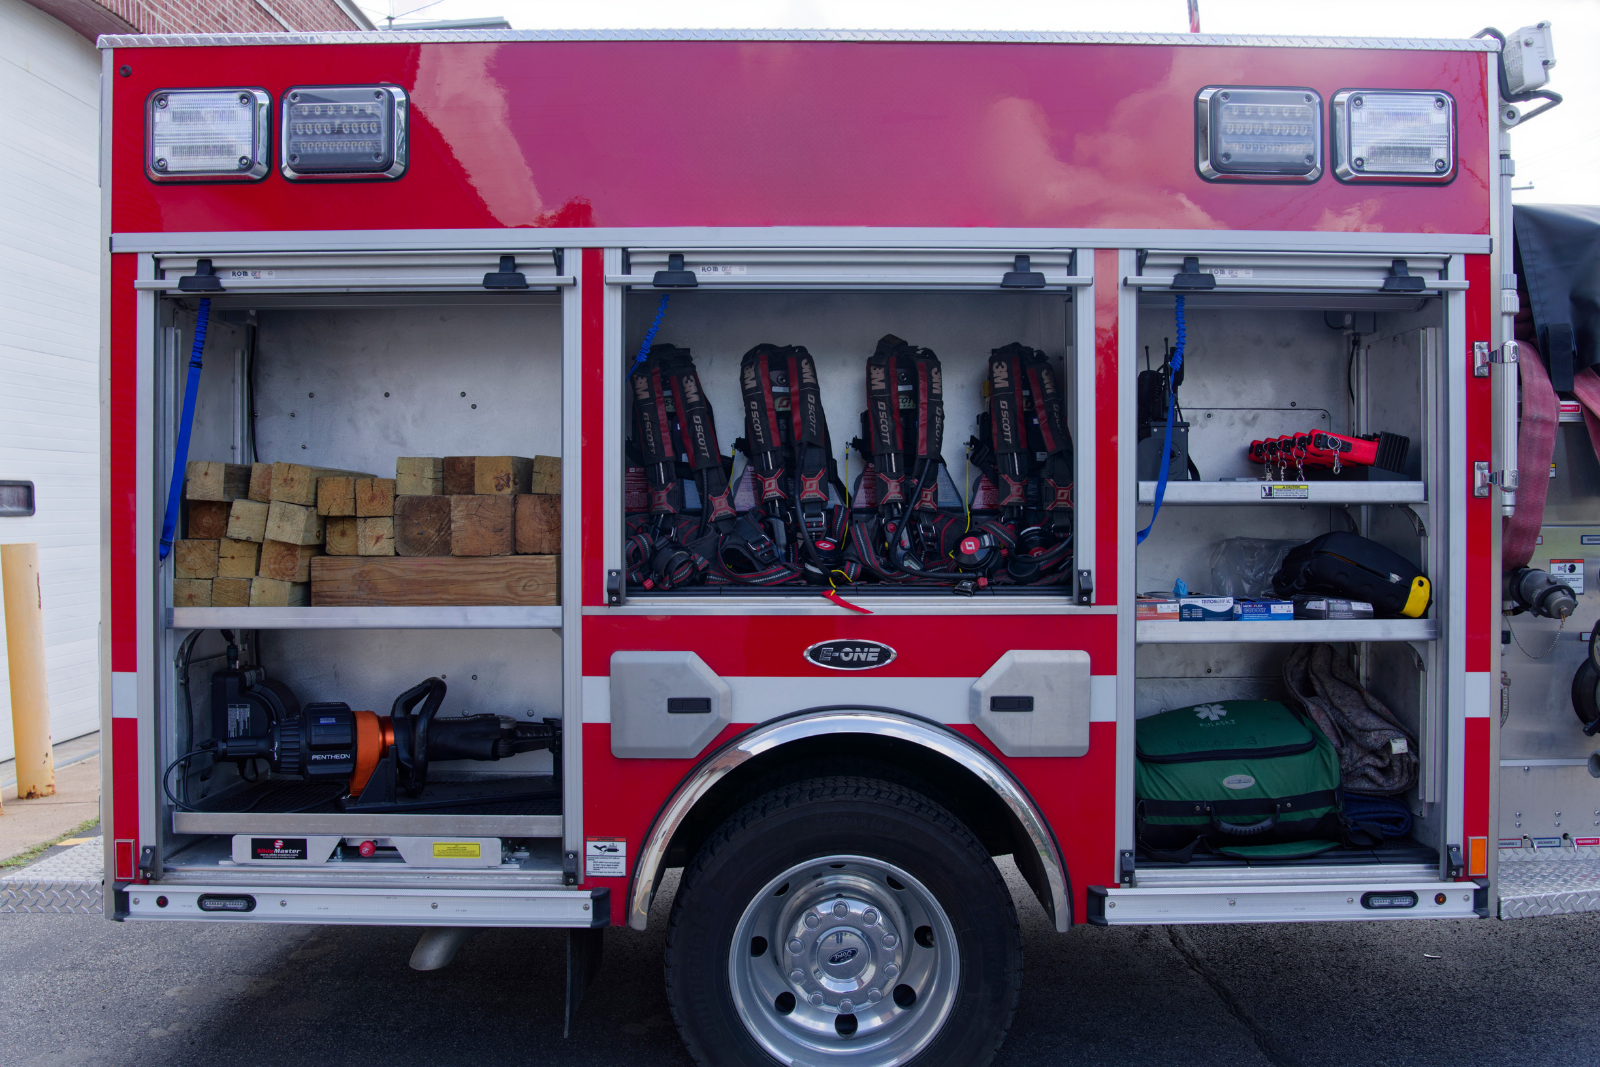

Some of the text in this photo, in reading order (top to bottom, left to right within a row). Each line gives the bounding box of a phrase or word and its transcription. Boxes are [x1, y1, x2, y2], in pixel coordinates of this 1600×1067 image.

[743, 361, 757, 390] 3M
[802, 358, 817, 384] 3M
[870, 365, 886, 391] 3M
[931, 367, 942, 395] 3M
[992, 361, 1010, 389] 3M
[632, 374, 651, 401] 3M
[682, 374, 701, 404] 3M
[750, 410, 766, 444] SCOTT
[807, 404, 818, 437] SCOTT
[878, 411, 892, 446] SCOTT
[1000, 410, 1014, 444] SCOTT
[644, 420, 657, 455] SCOTT
[695, 424, 711, 459] SCOTT
[819, 647, 881, 662] E-ONE
[1199, 719, 1237, 728] PULASKI
